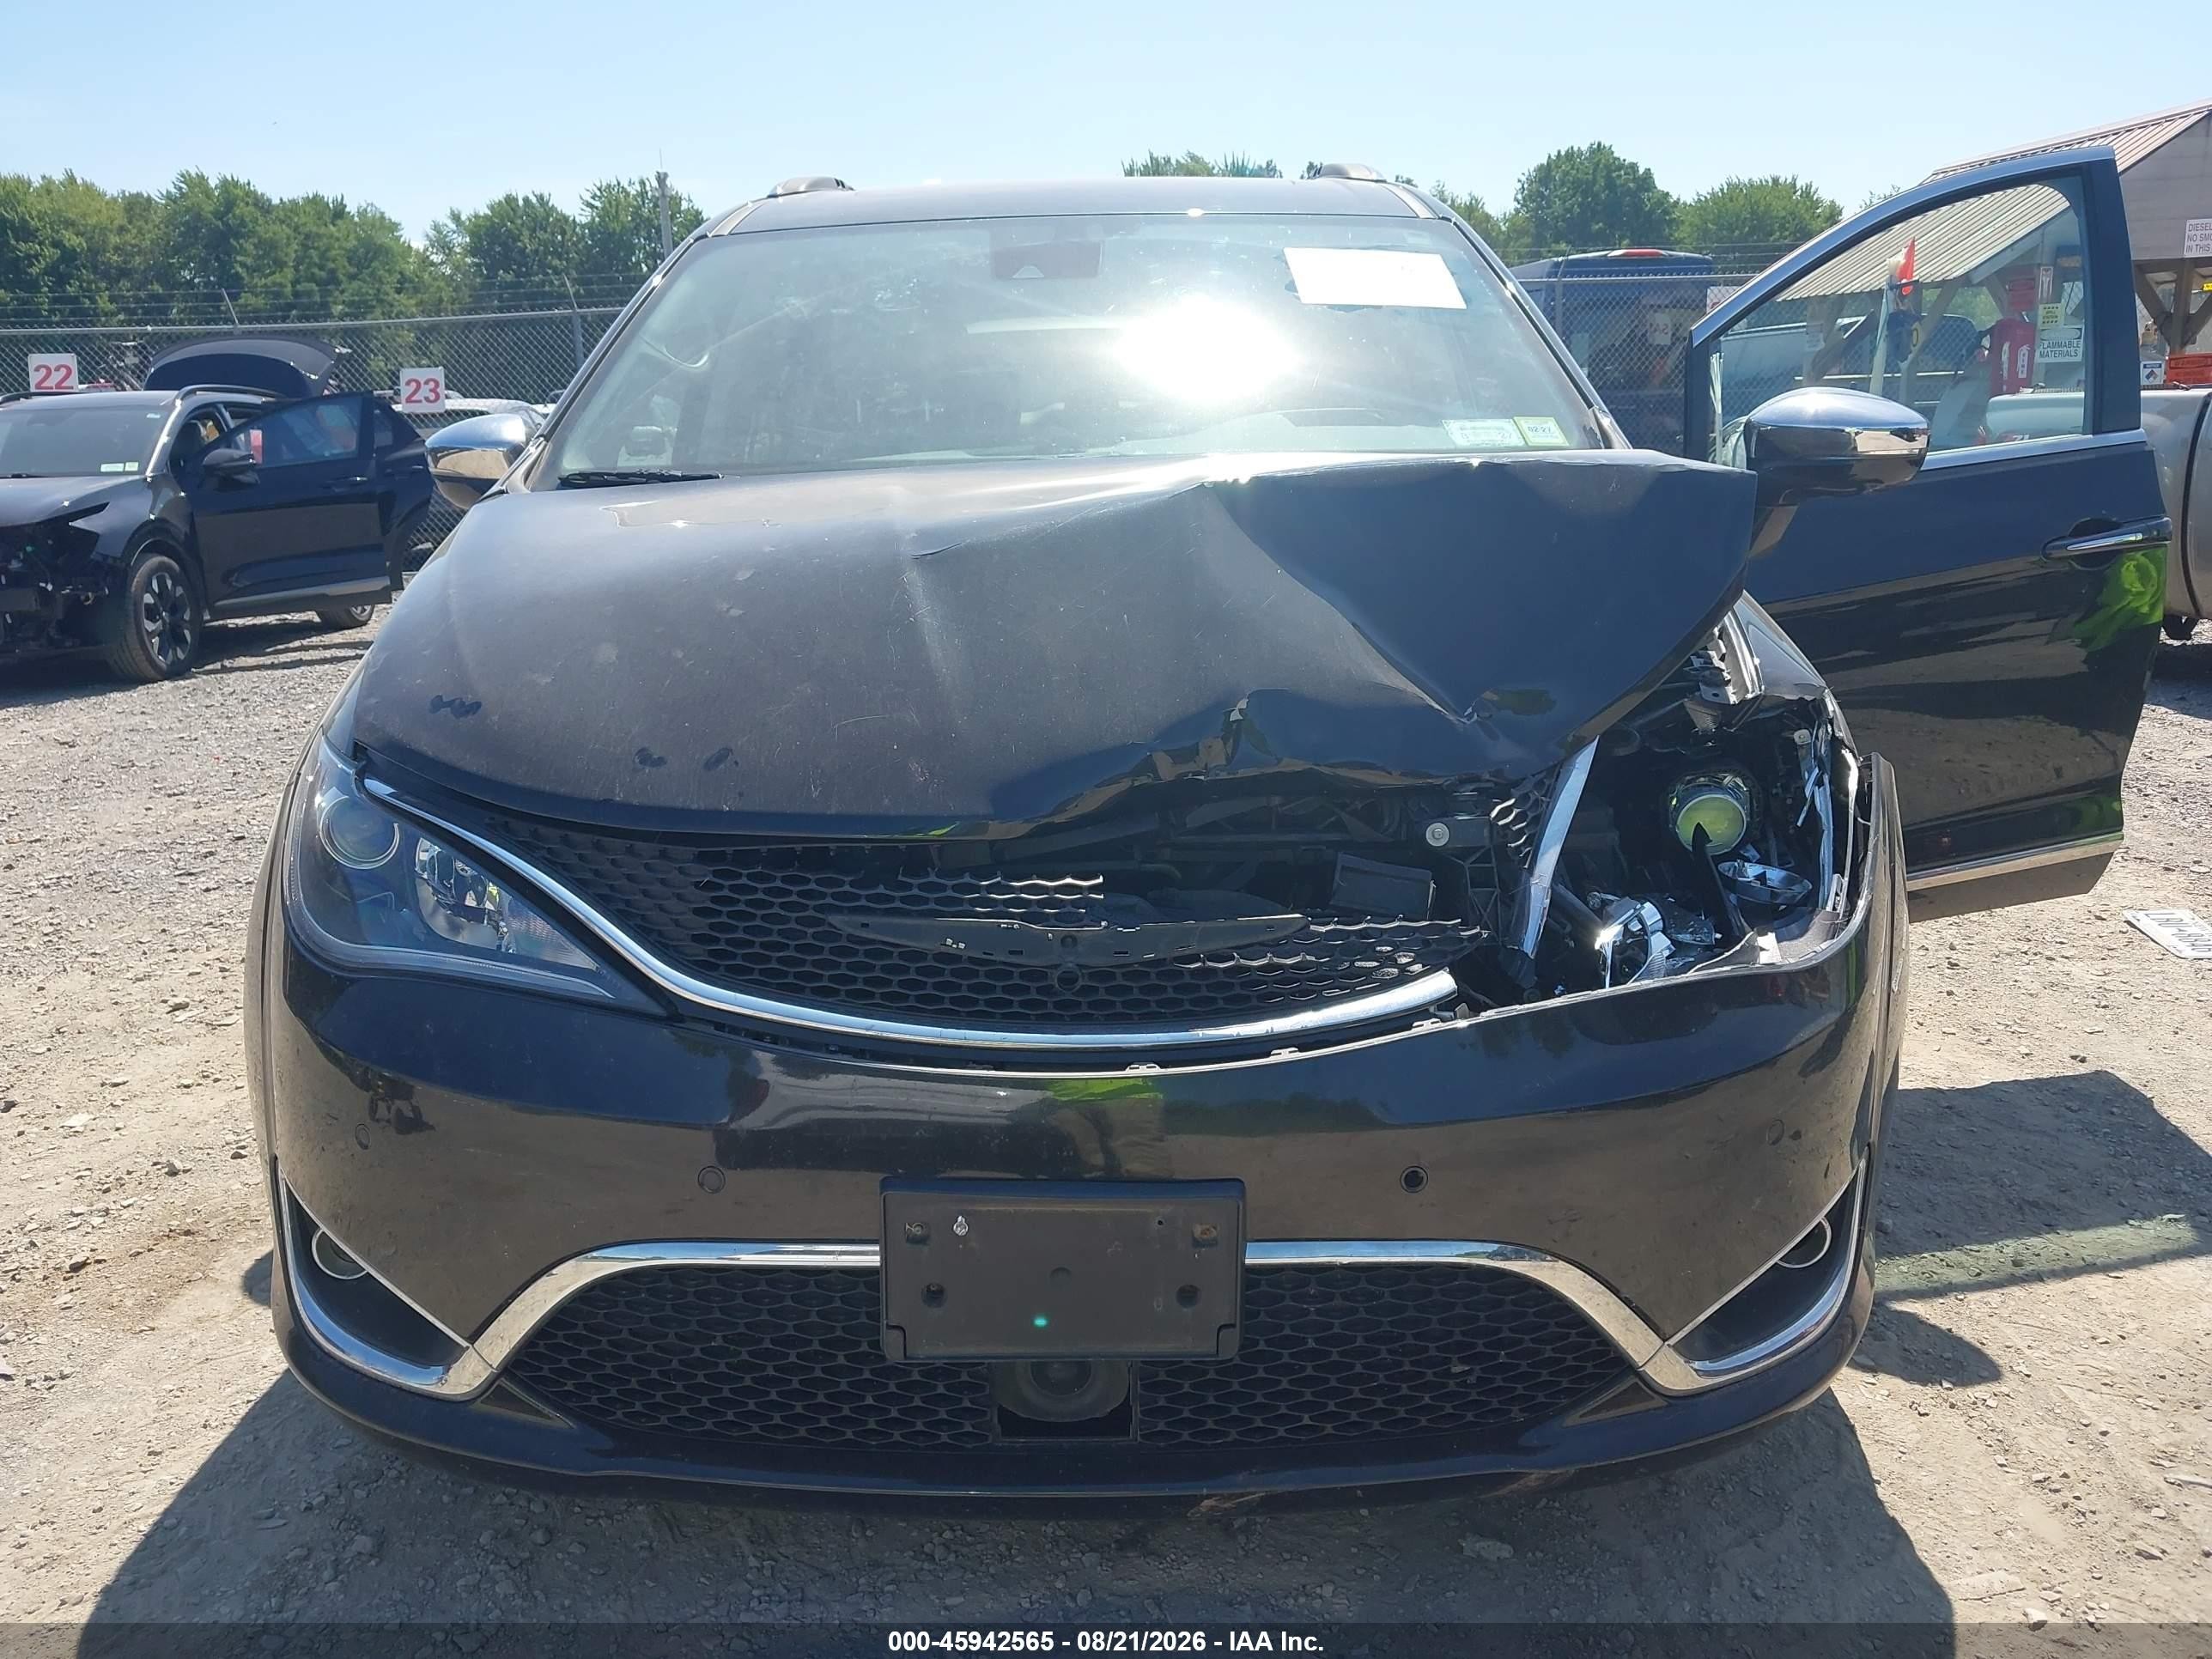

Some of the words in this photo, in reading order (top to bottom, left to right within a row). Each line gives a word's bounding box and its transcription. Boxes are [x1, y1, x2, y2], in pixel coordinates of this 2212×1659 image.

[2189, 223, 2212, 232] DIESEL
[2187, 234, 2197, 242] NO
[2186, 245, 2192, 253] IN
[2196, 243, 2211, 253] THIS
[2040, 340, 2081, 349] FLAMMABLE
[2039, 349, 2078, 358] MATERIALS
[33, 363, 75, 390] 22
[404, 378, 441, 404] 23
